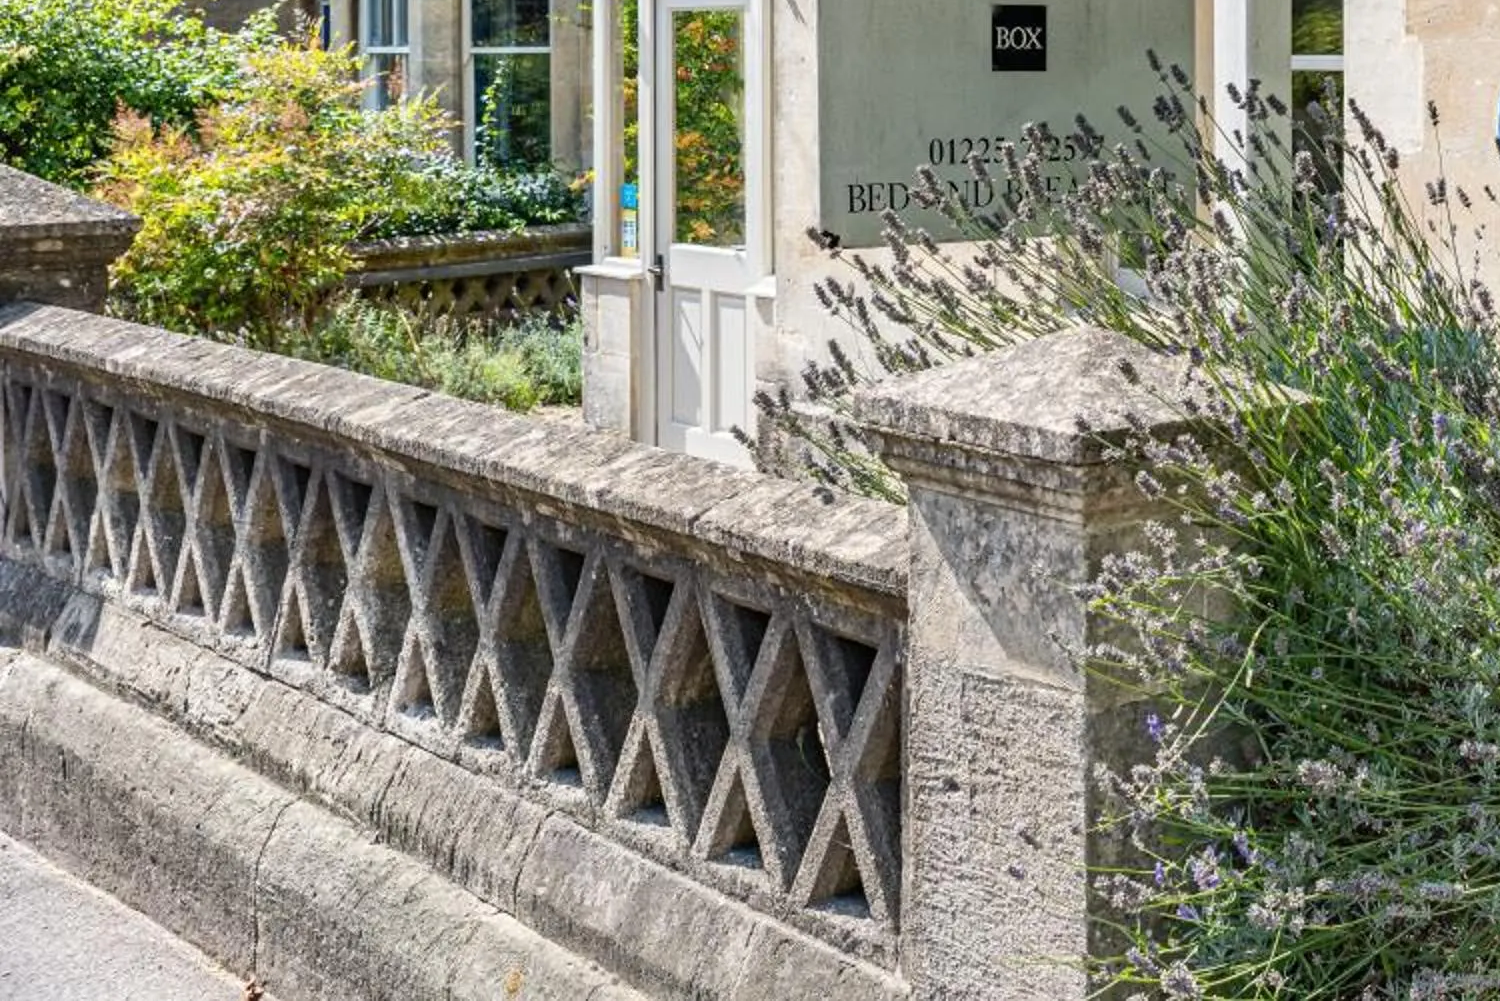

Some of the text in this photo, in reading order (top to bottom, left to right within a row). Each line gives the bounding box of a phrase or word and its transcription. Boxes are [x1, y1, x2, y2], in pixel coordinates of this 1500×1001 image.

[995, 26, 1043, 49] BOX
[929, 136, 1005, 166] 01225
[848, 182, 910, 214] BED
